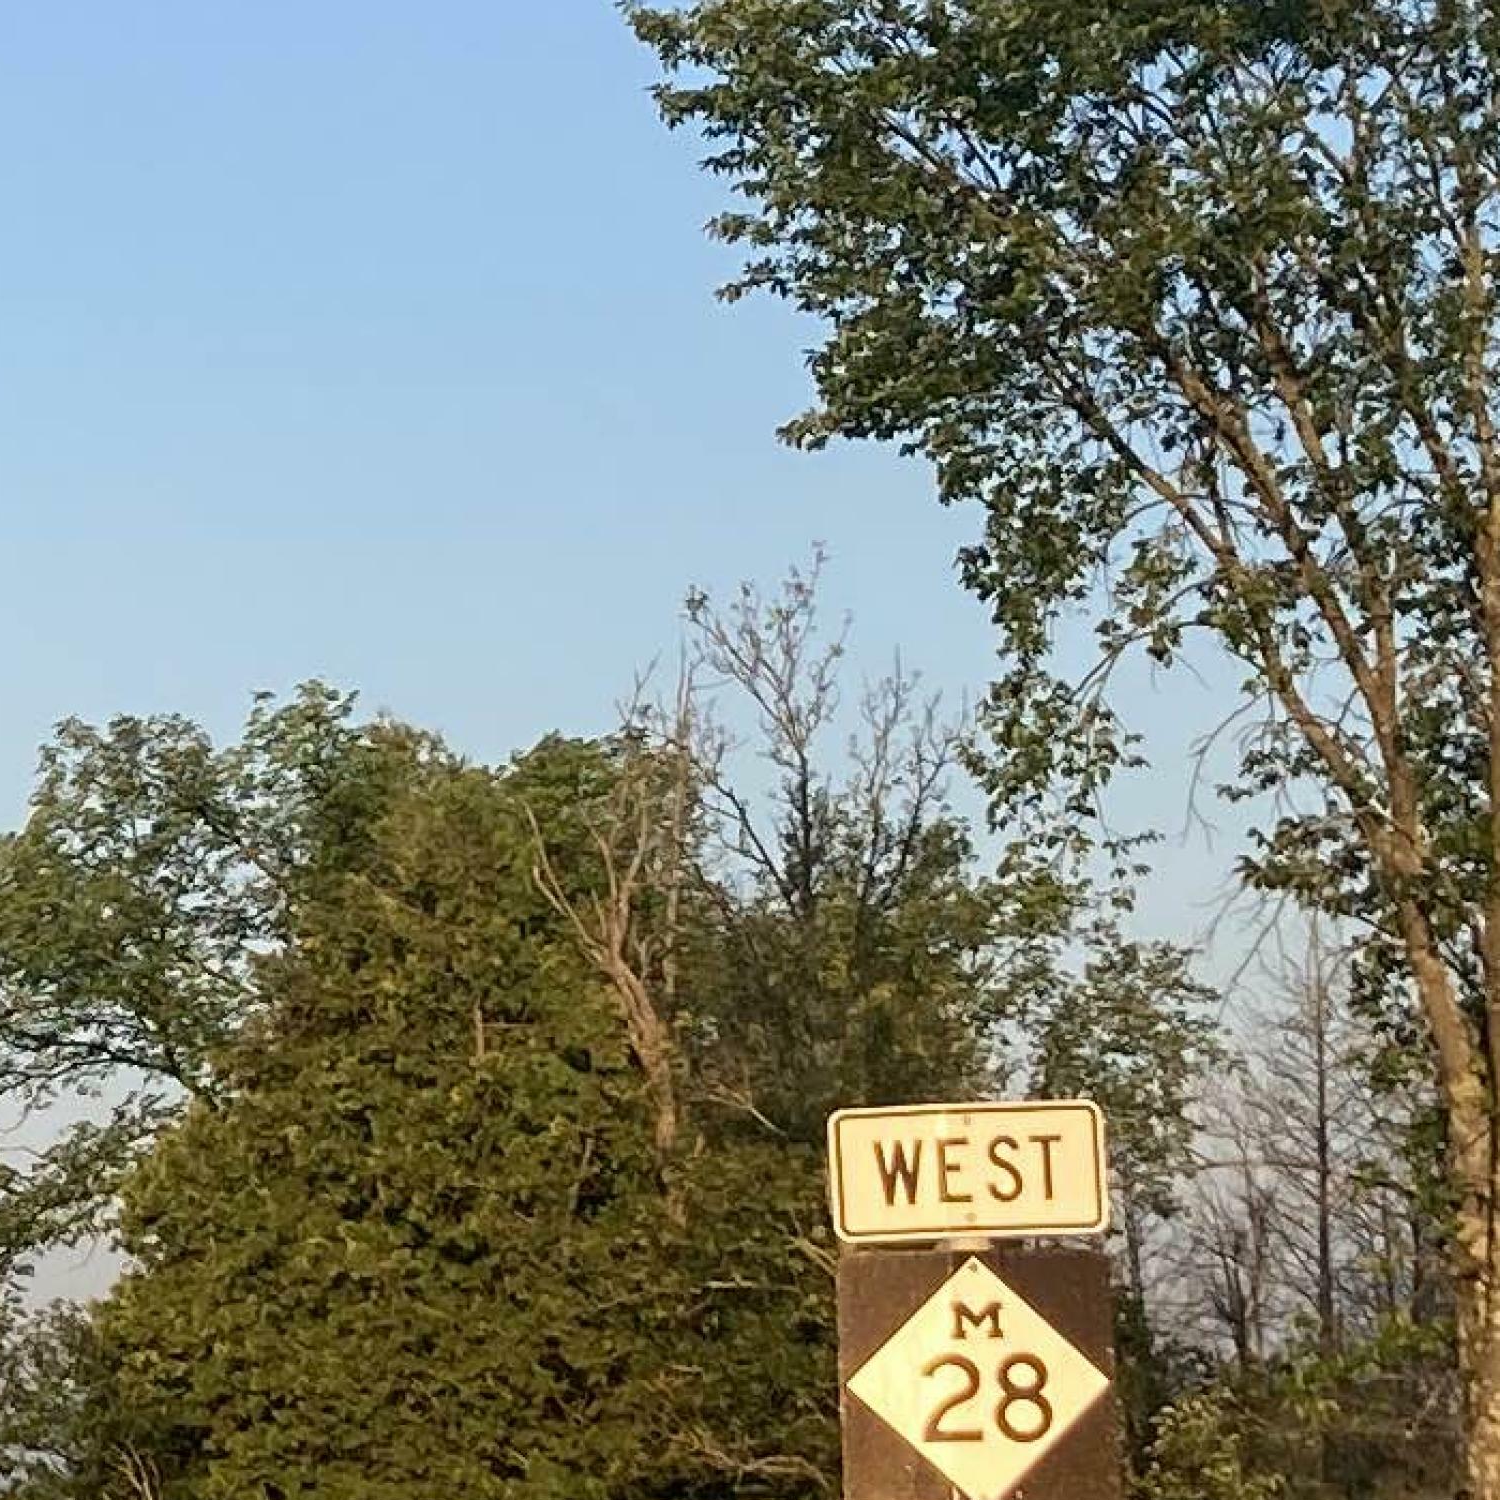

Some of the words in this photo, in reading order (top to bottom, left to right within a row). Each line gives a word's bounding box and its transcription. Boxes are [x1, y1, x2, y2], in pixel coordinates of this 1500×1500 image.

[873, 1135, 1061, 1206] WEST
[951, 1299, 1004, 1340] M
[922, 1353, 1053, 1443] 28
